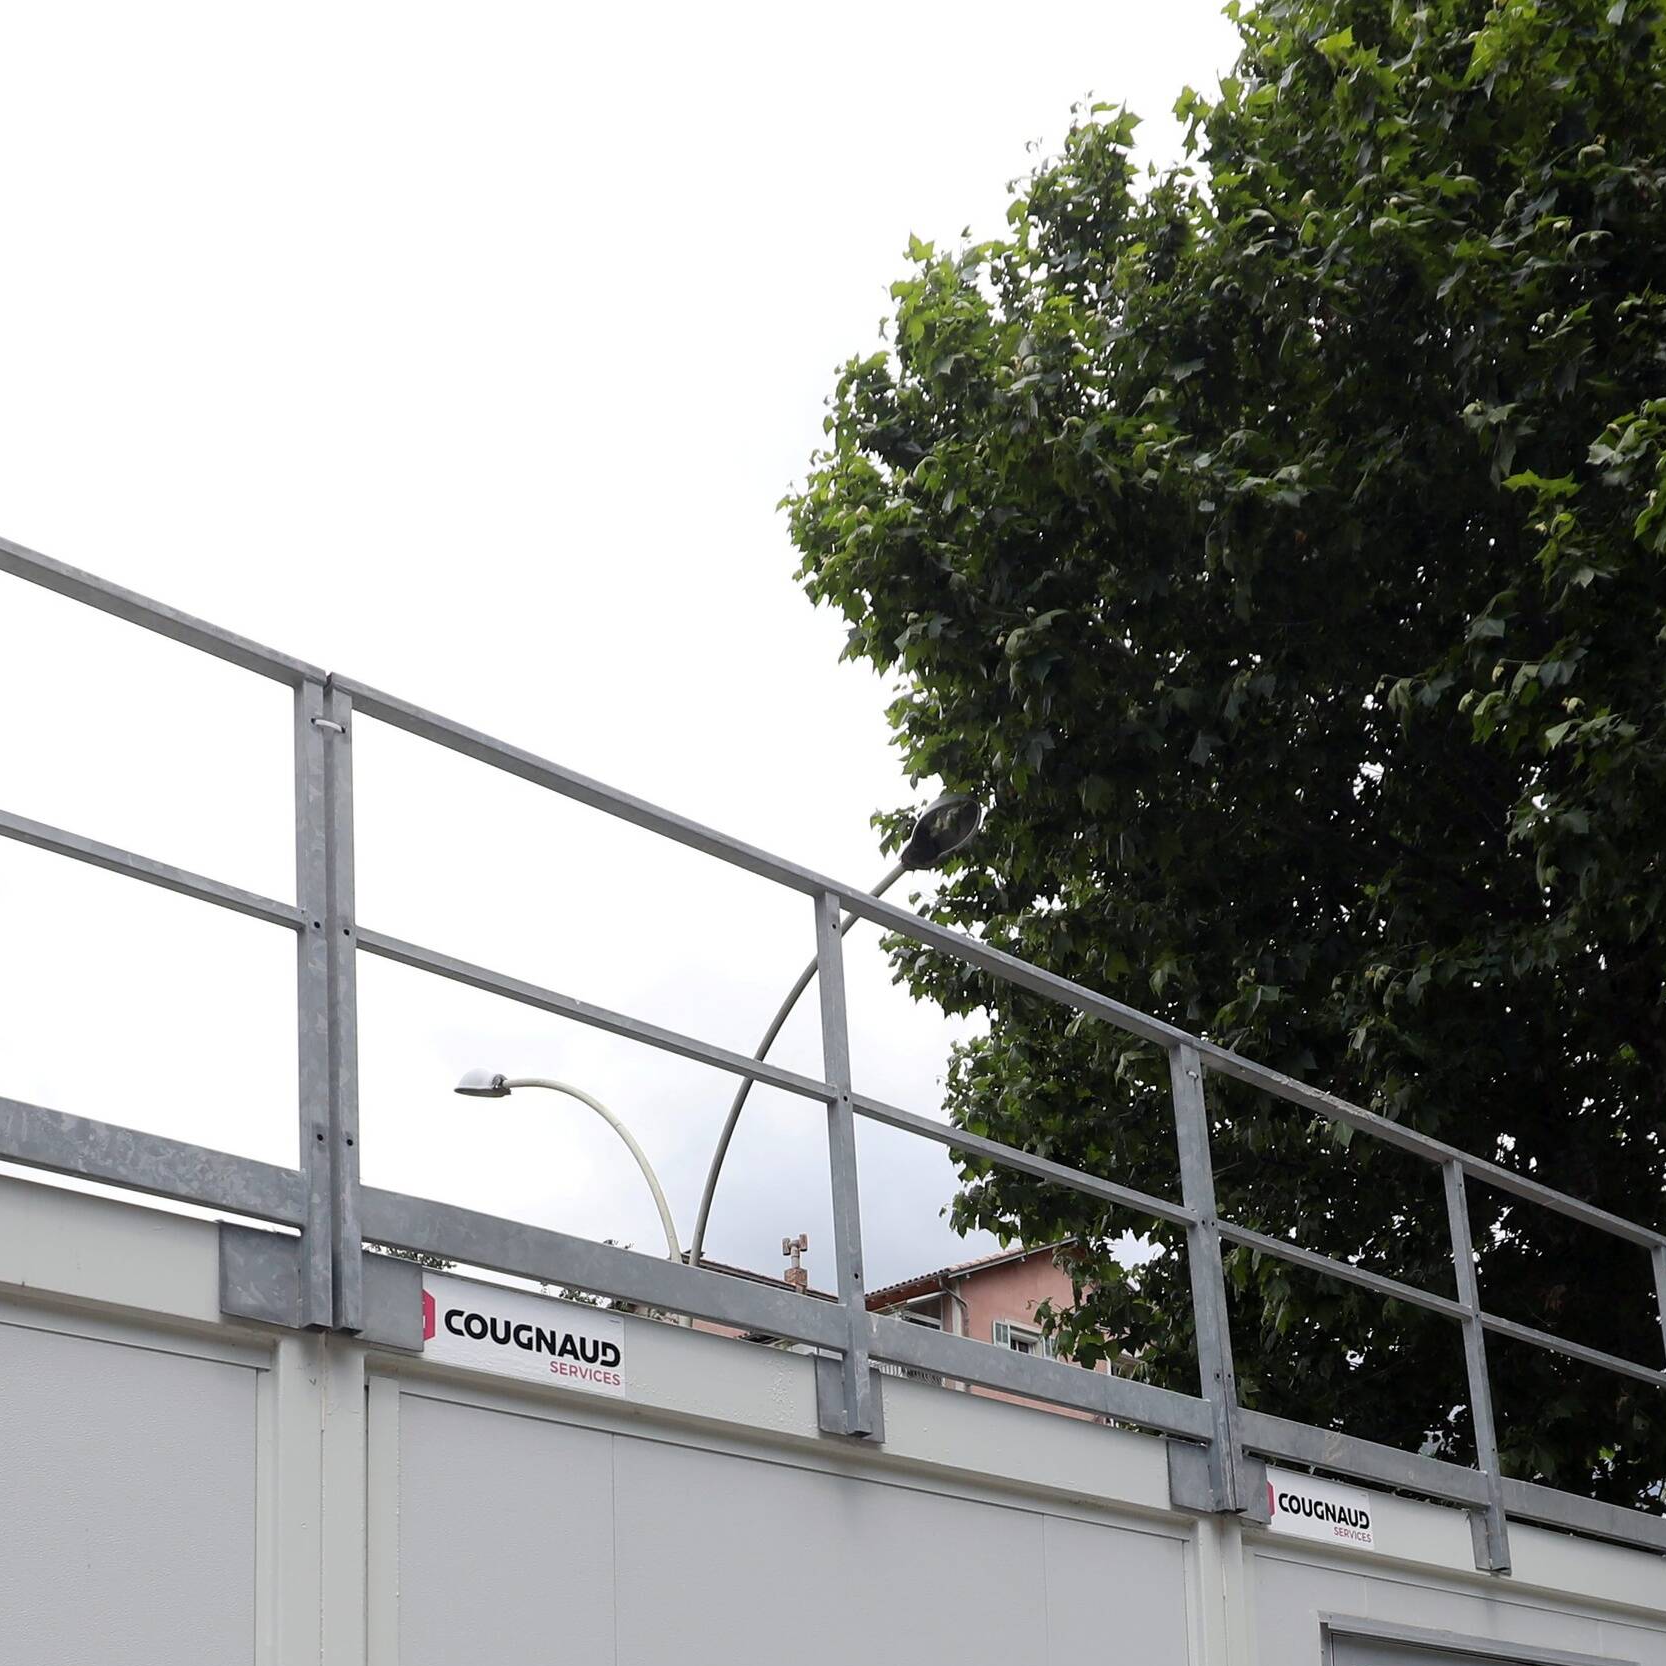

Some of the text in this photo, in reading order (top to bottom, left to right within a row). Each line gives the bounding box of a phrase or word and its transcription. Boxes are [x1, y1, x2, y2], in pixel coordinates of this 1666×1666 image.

[444, 1309, 621, 1367] COUGNAUD
[550, 1361, 621, 1386] SERVICES
[1278, 1493, 1370, 1529] COUGNAUD
[1334, 1527, 1372, 1543] SERVICES
